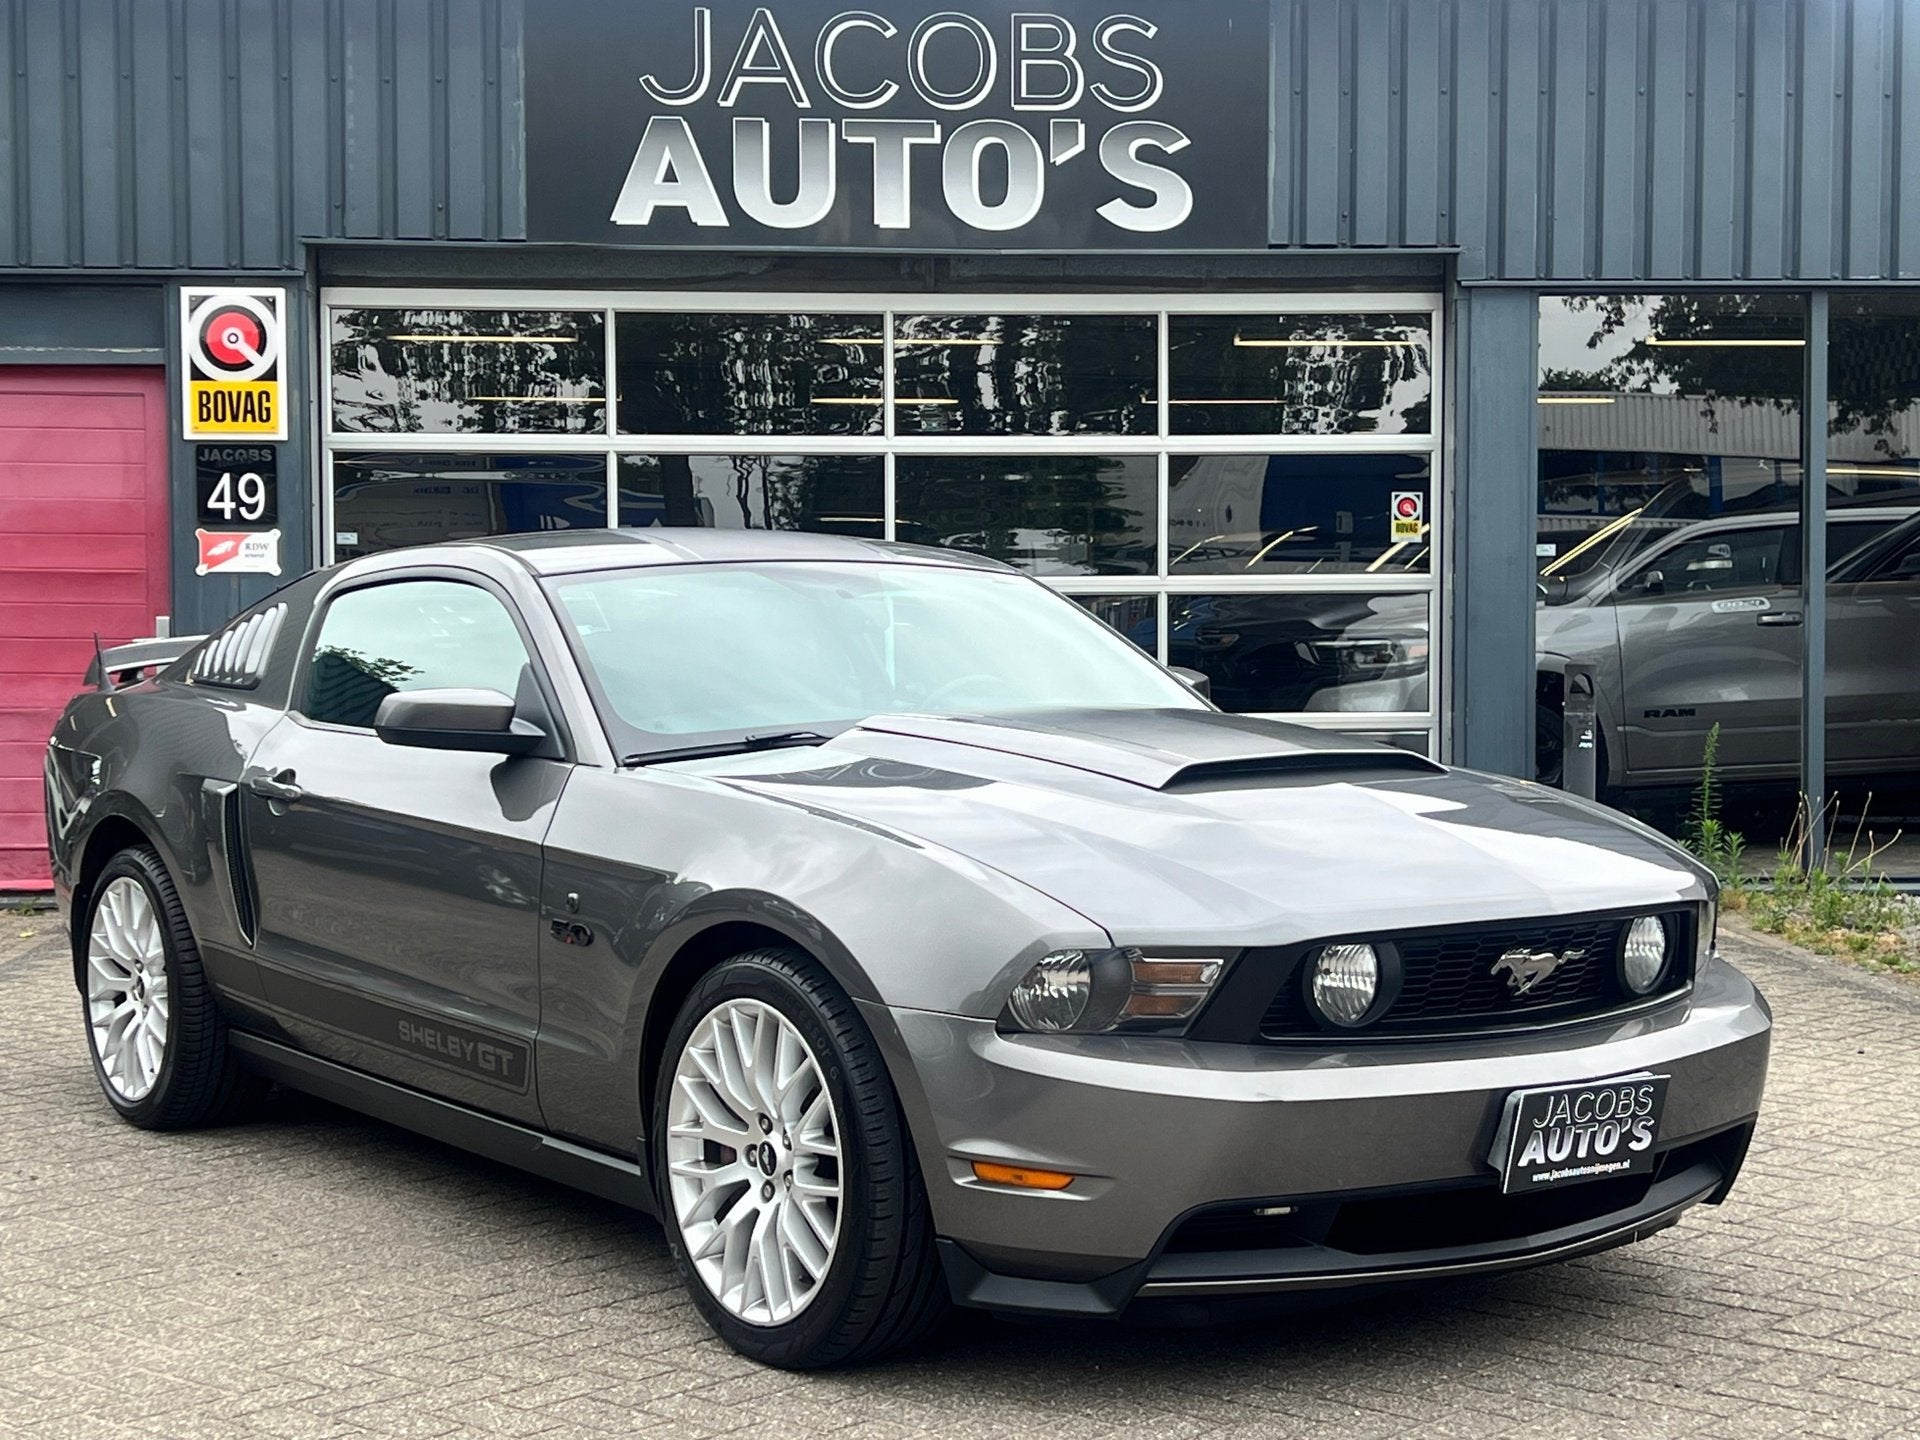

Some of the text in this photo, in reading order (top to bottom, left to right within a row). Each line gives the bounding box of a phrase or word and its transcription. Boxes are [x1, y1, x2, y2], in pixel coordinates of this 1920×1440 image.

[638, 6, 1164, 112] JACOBS
[609, 115, 1194, 232] AUTO'S
[198, 390, 271, 423] BOVAG
[199, 448, 273, 462] JACOBS
[207, 472, 265, 520] 49
[1643, 708, 1696, 718] RAM
[399, 1020, 514, 1076] SHELBY GT
[1532, 1084, 1654, 1128] JACOBS
[1517, 1116, 1655, 1167] AUTO'S
